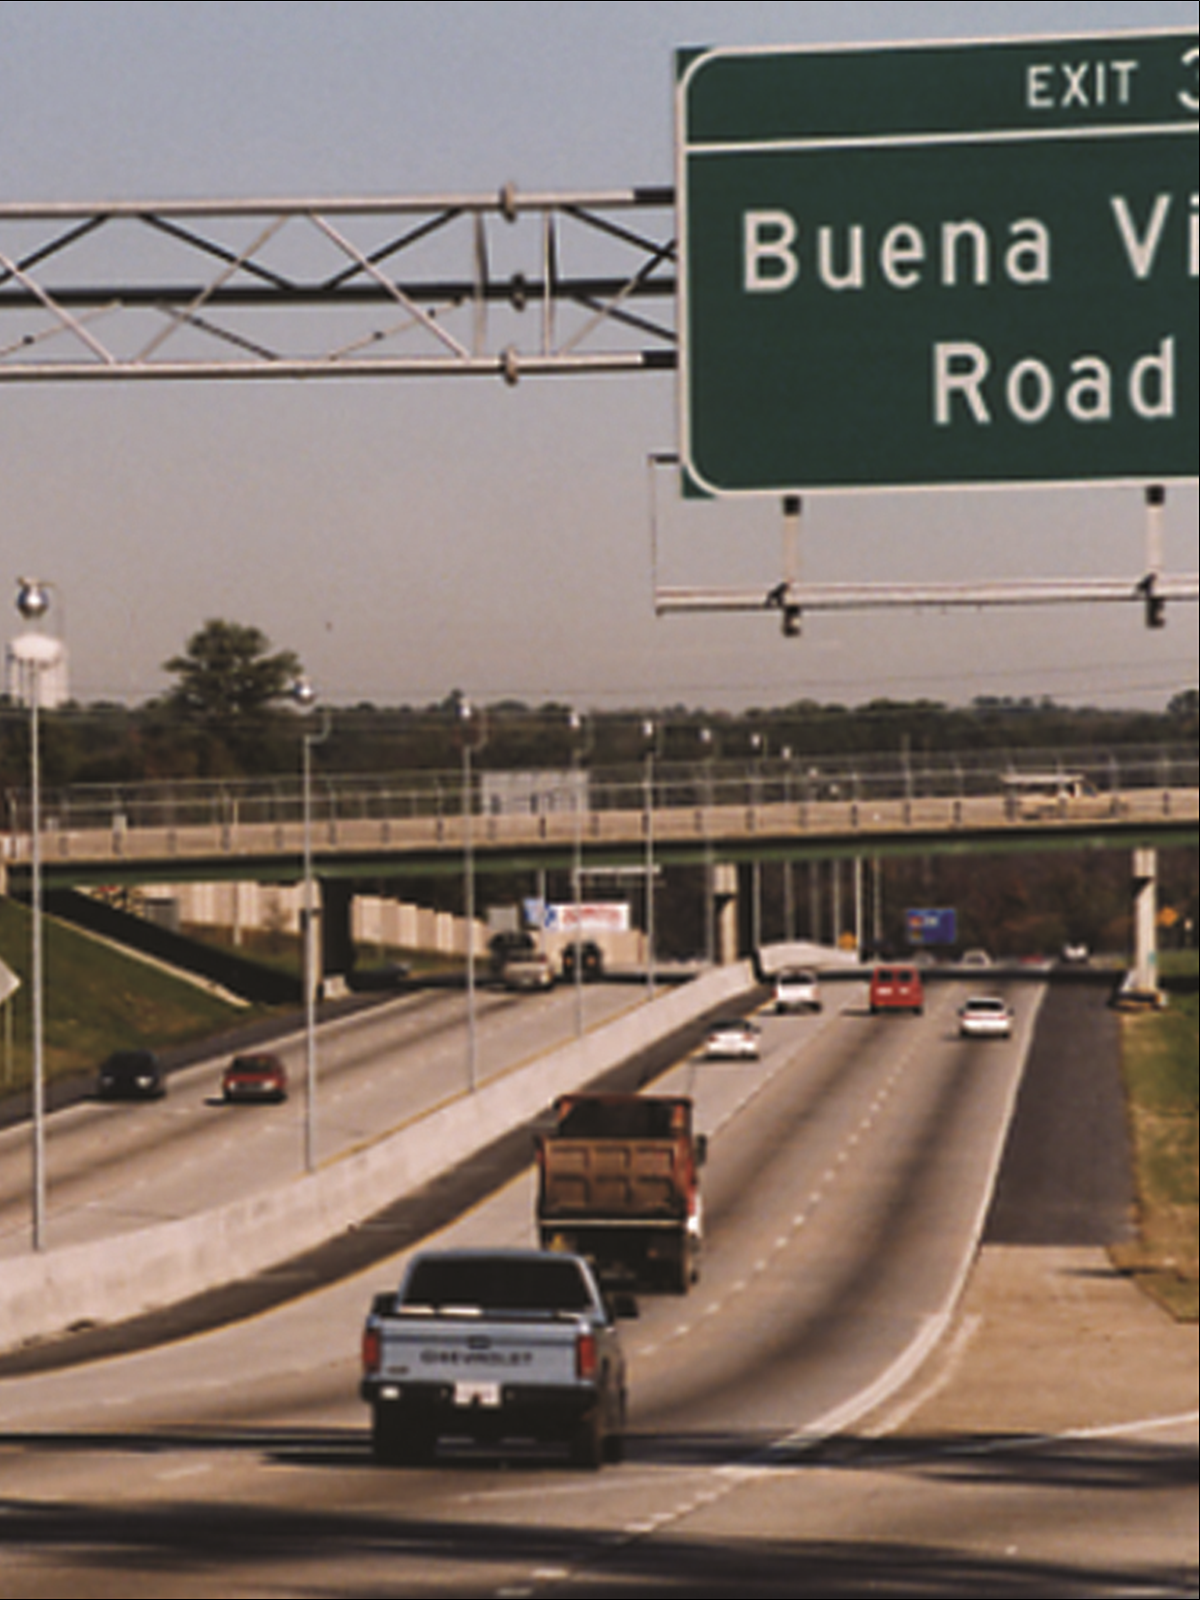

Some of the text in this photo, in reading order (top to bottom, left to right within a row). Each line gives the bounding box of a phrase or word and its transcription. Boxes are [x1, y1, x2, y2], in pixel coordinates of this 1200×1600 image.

[1027, 60, 1138, 108] EXIT
[743, 210, 1050, 292] Buena
[934, 336, 1175, 425] Road
